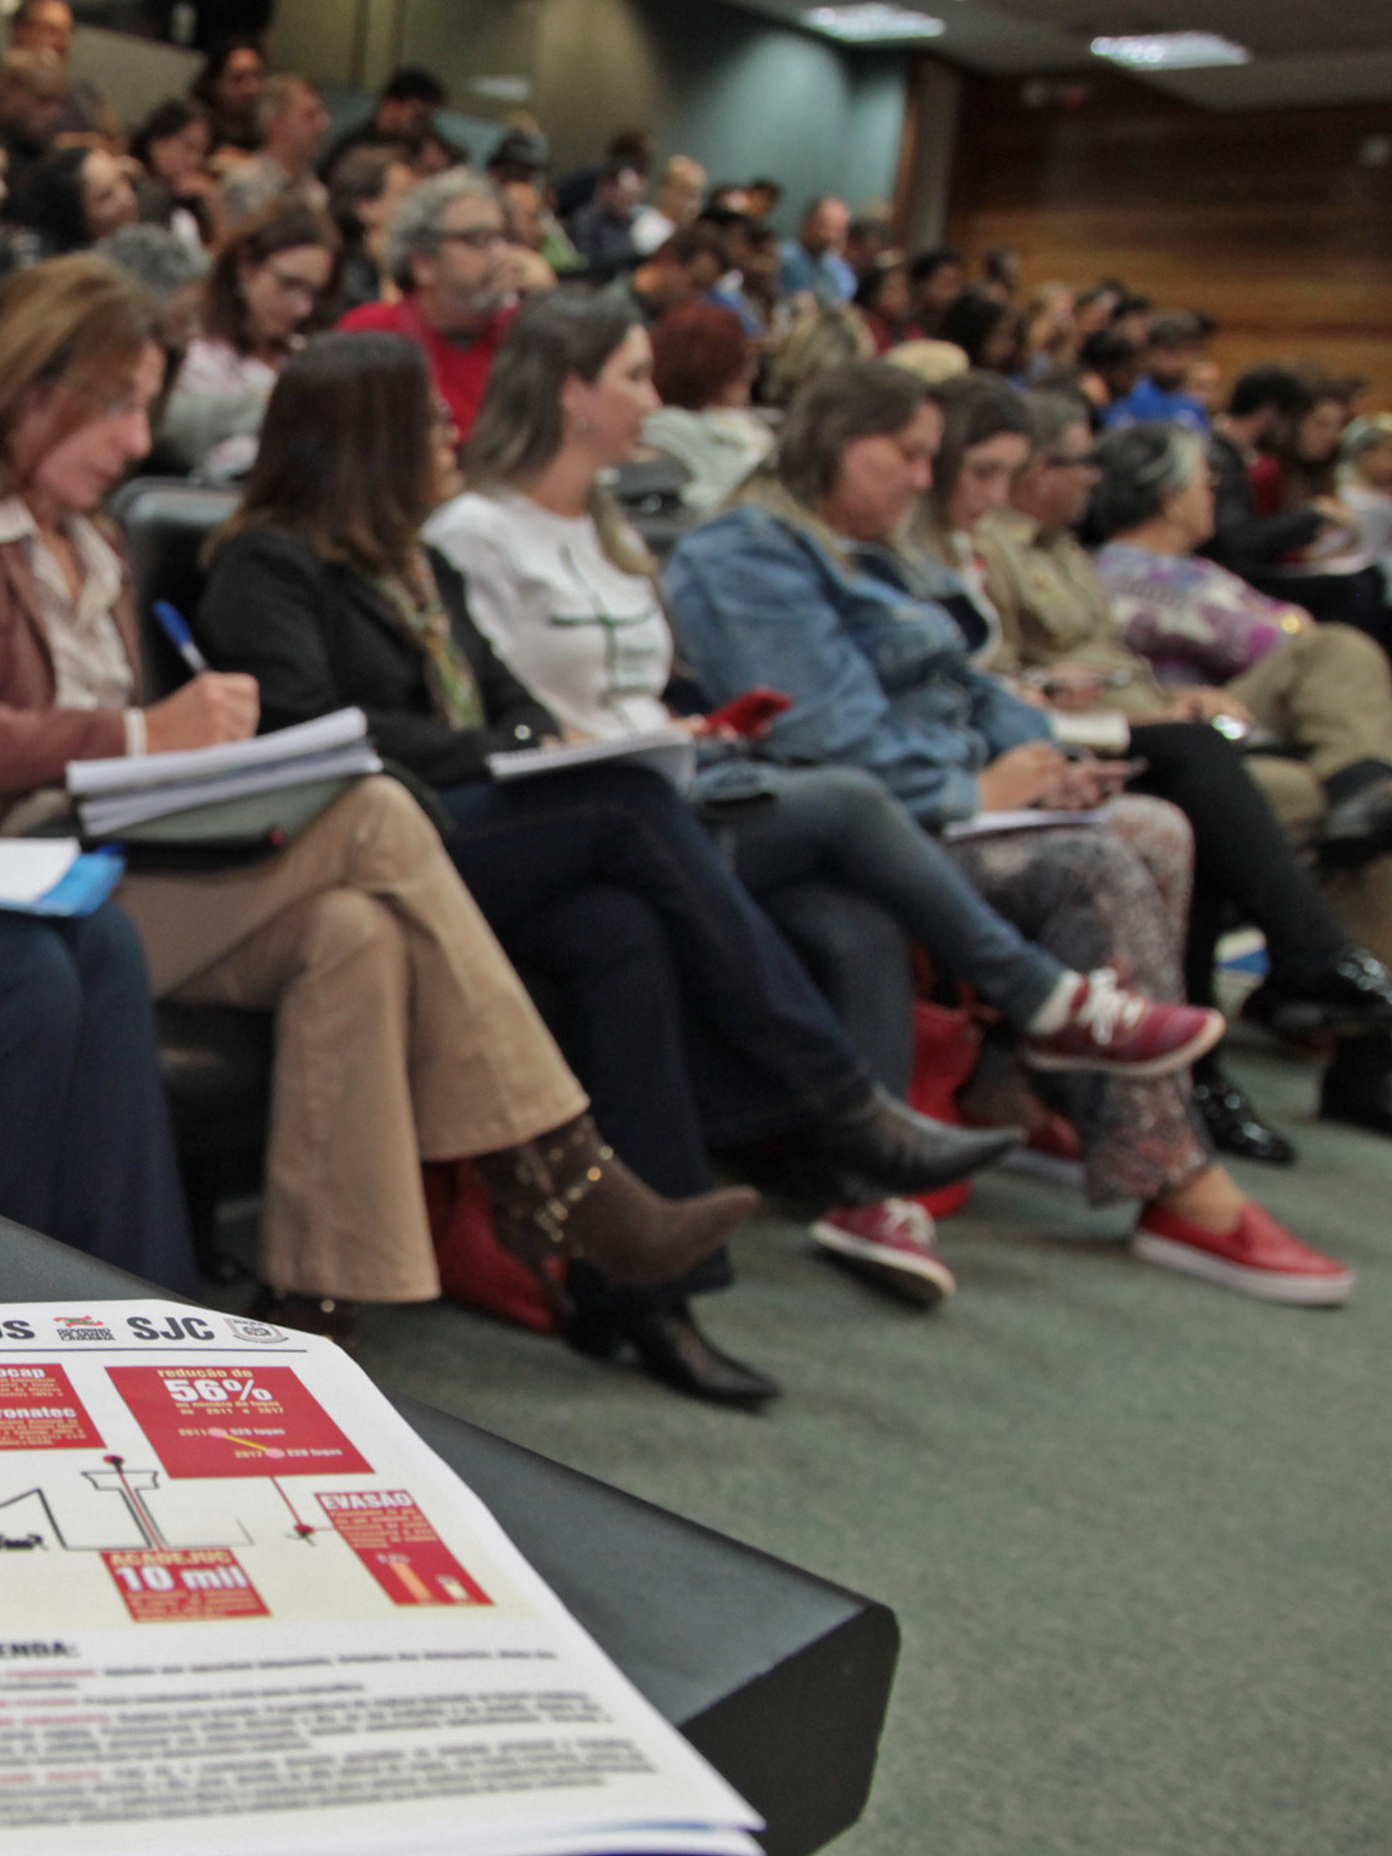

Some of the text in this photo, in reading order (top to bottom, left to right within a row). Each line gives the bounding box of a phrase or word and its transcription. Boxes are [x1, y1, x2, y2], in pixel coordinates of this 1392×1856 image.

[126, 1316, 215, 1341] SJC
[157, 1368, 253, 1378] redução de
[163, 1378, 273, 1402] 56%
[115, 1563, 249, 1592] 10 mil
